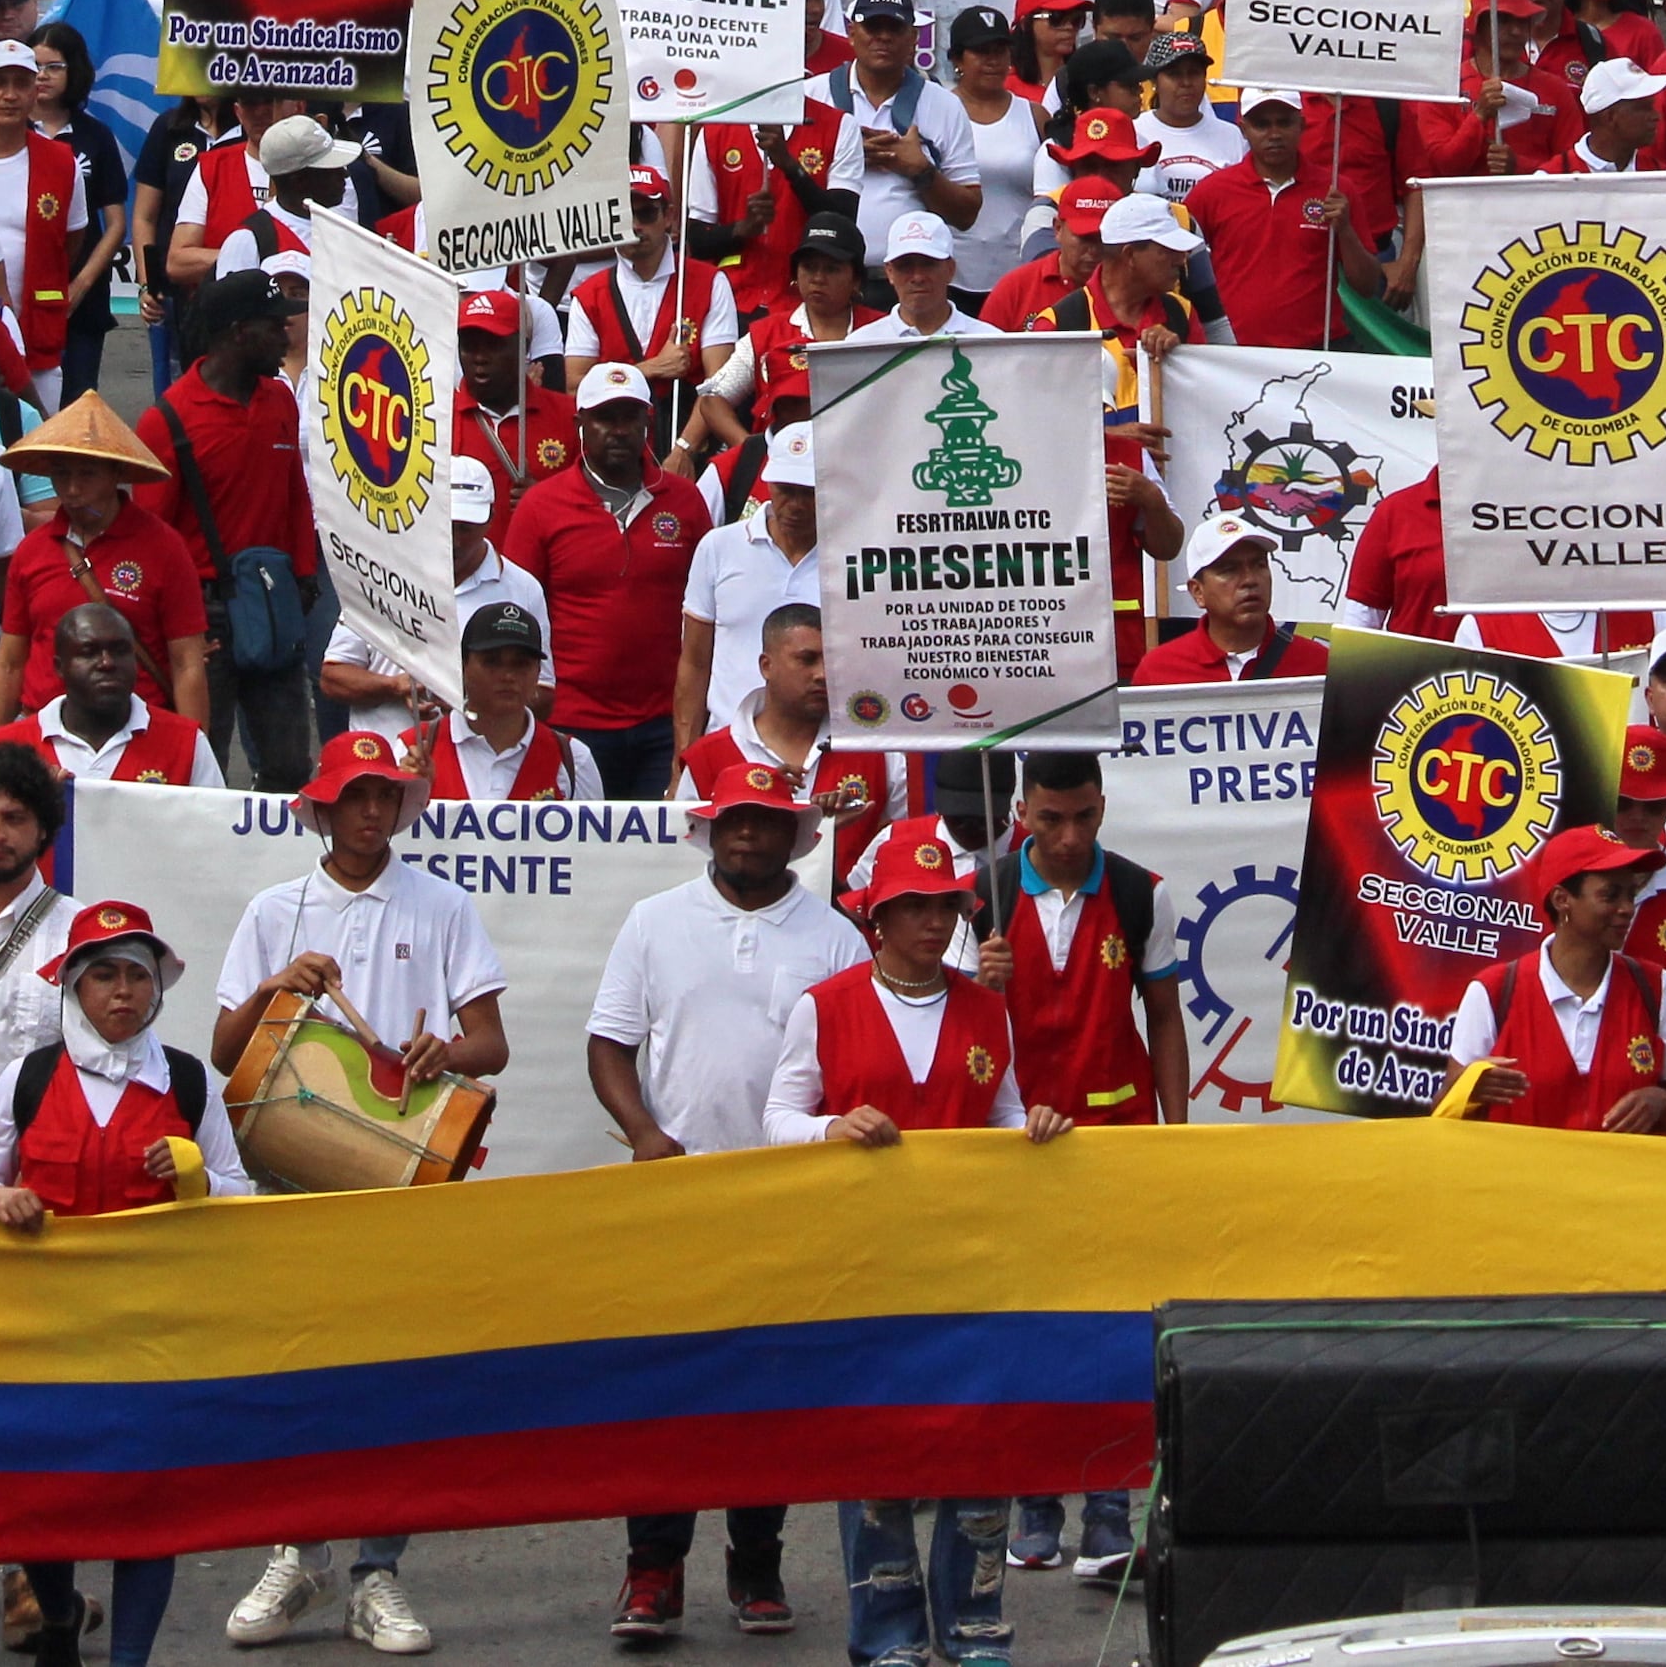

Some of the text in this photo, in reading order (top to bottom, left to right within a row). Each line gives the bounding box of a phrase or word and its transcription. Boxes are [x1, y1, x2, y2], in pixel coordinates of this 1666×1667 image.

[169, 15, 401, 53] Por un Sindicalismo
[620, 9, 769, 34] TRABAJO DECENTE
[1248, 0, 1442, 36] SECCIONAL
[630, 27, 758, 49] PARA UNA VIDA
[666, 44, 721, 60] DIGNA
[1288, 32, 1398, 62] VALLE
[209, 55, 354, 87] de Avanzada
[481, 51, 571, 111] CTC
[437, 198, 624, 272] SECCIONAL VALLE
[1516, 312, 1655, 374] CTC
[896, 509, 1052, 534] FESRTRALVA CTC
[845, 536, 1090, 601] ¡PRESENTE!
[885, 599, 1066, 616] POR LA UNIDAD DE TODOS
[860, 630, 1095, 650] TRABAJADORAS PARA CONSEGUIR
[901, 616, 1052, 632] LOS TRABAJADORES Y
[903, 664, 1056, 680] ECONÓMICO Y SOCIAL
[907, 649, 1050, 664] NUESTRO BIENESTAR
[1415, 747, 1518, 809] CTC
[411, 803, 678, 846] NACIONAL
[1357, 874, 1545, 933] SECCIONAL
[1393, 912, 1500, 959] VALLE
